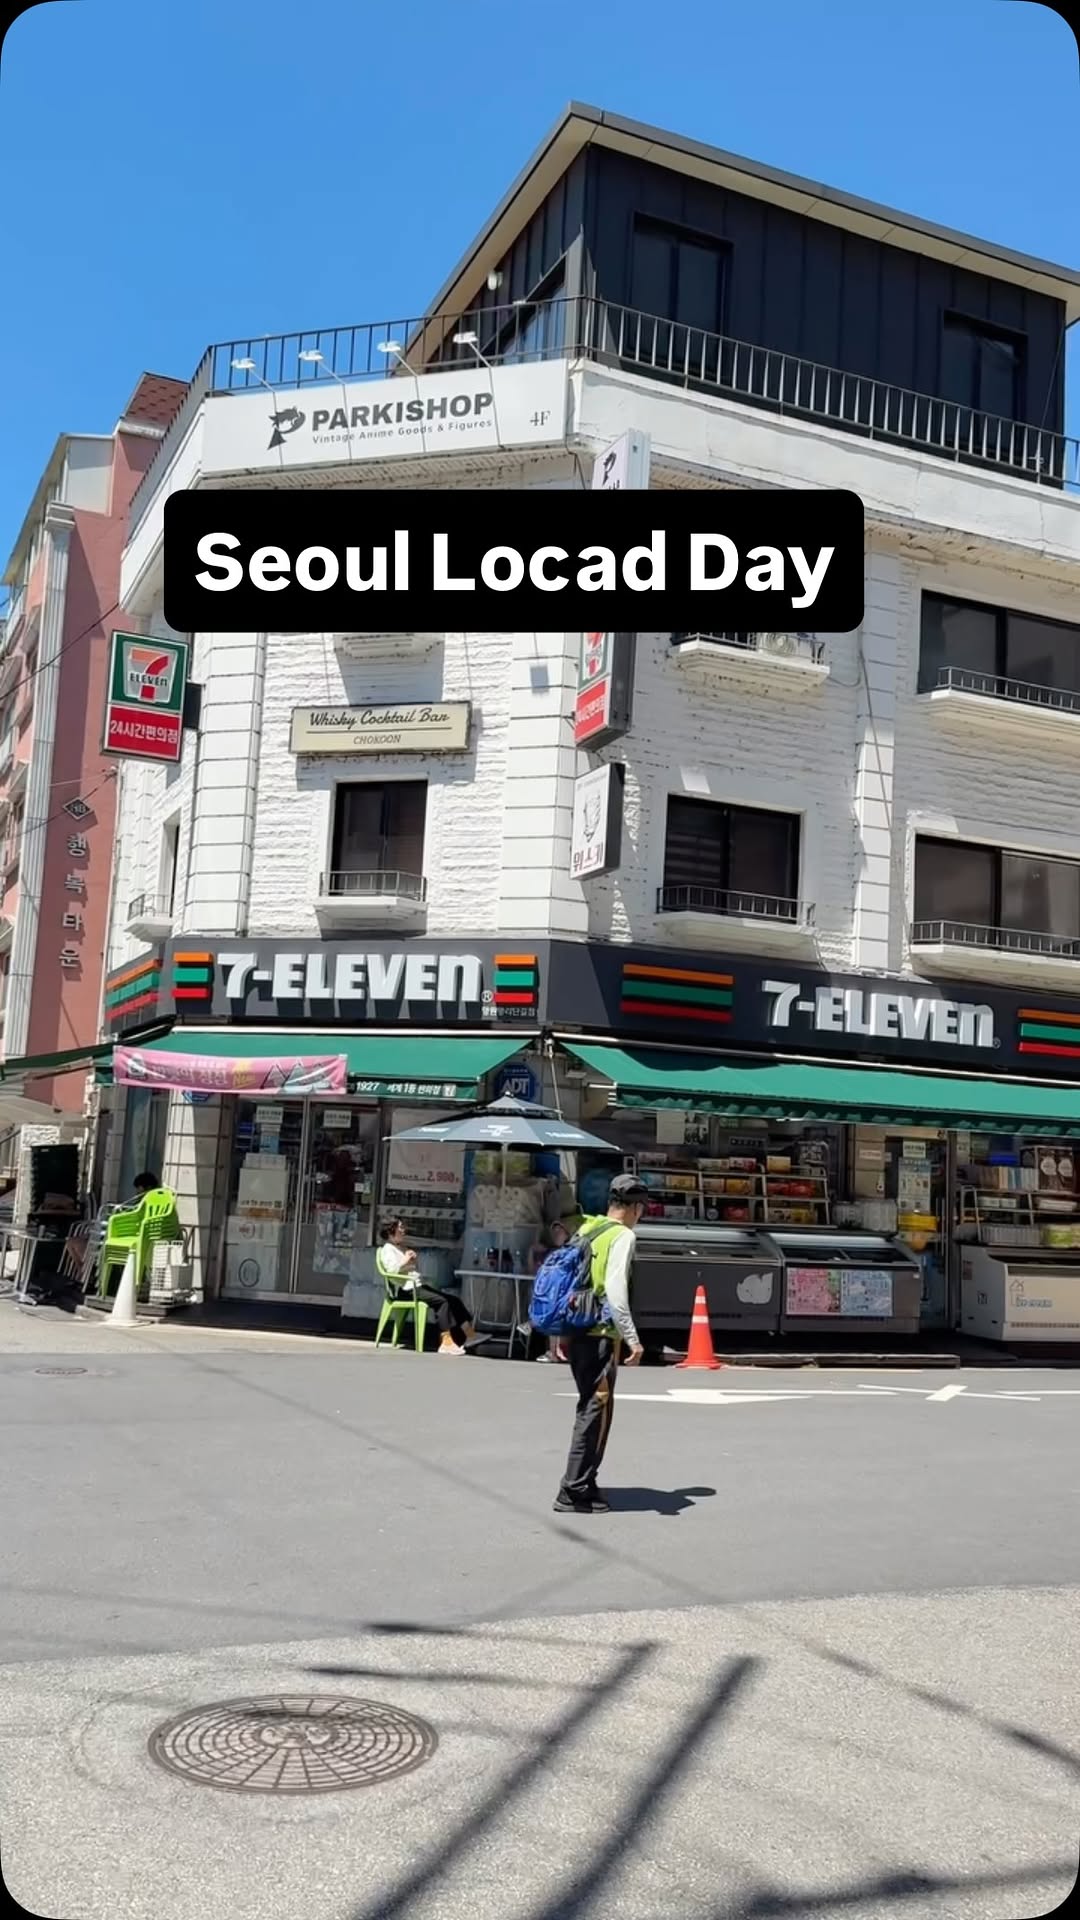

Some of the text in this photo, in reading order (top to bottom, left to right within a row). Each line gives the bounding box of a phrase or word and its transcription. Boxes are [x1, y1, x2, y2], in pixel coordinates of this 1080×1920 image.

[312, 392, 494, 432] PARKISHOP
[530, 410, 551, 426] 4F
[312, 419, 493, 444] Vintage Anime Goods & Figures
[310, 707, 450, 730] Whisky Cocktail Bar
[110, 719, 178, 744] 24시간편의점
[353, 734, 402, 745] CHOKOON
[356, 1081, 380, 1092] 1927
[500, 1077, 529, 1094] ADT
